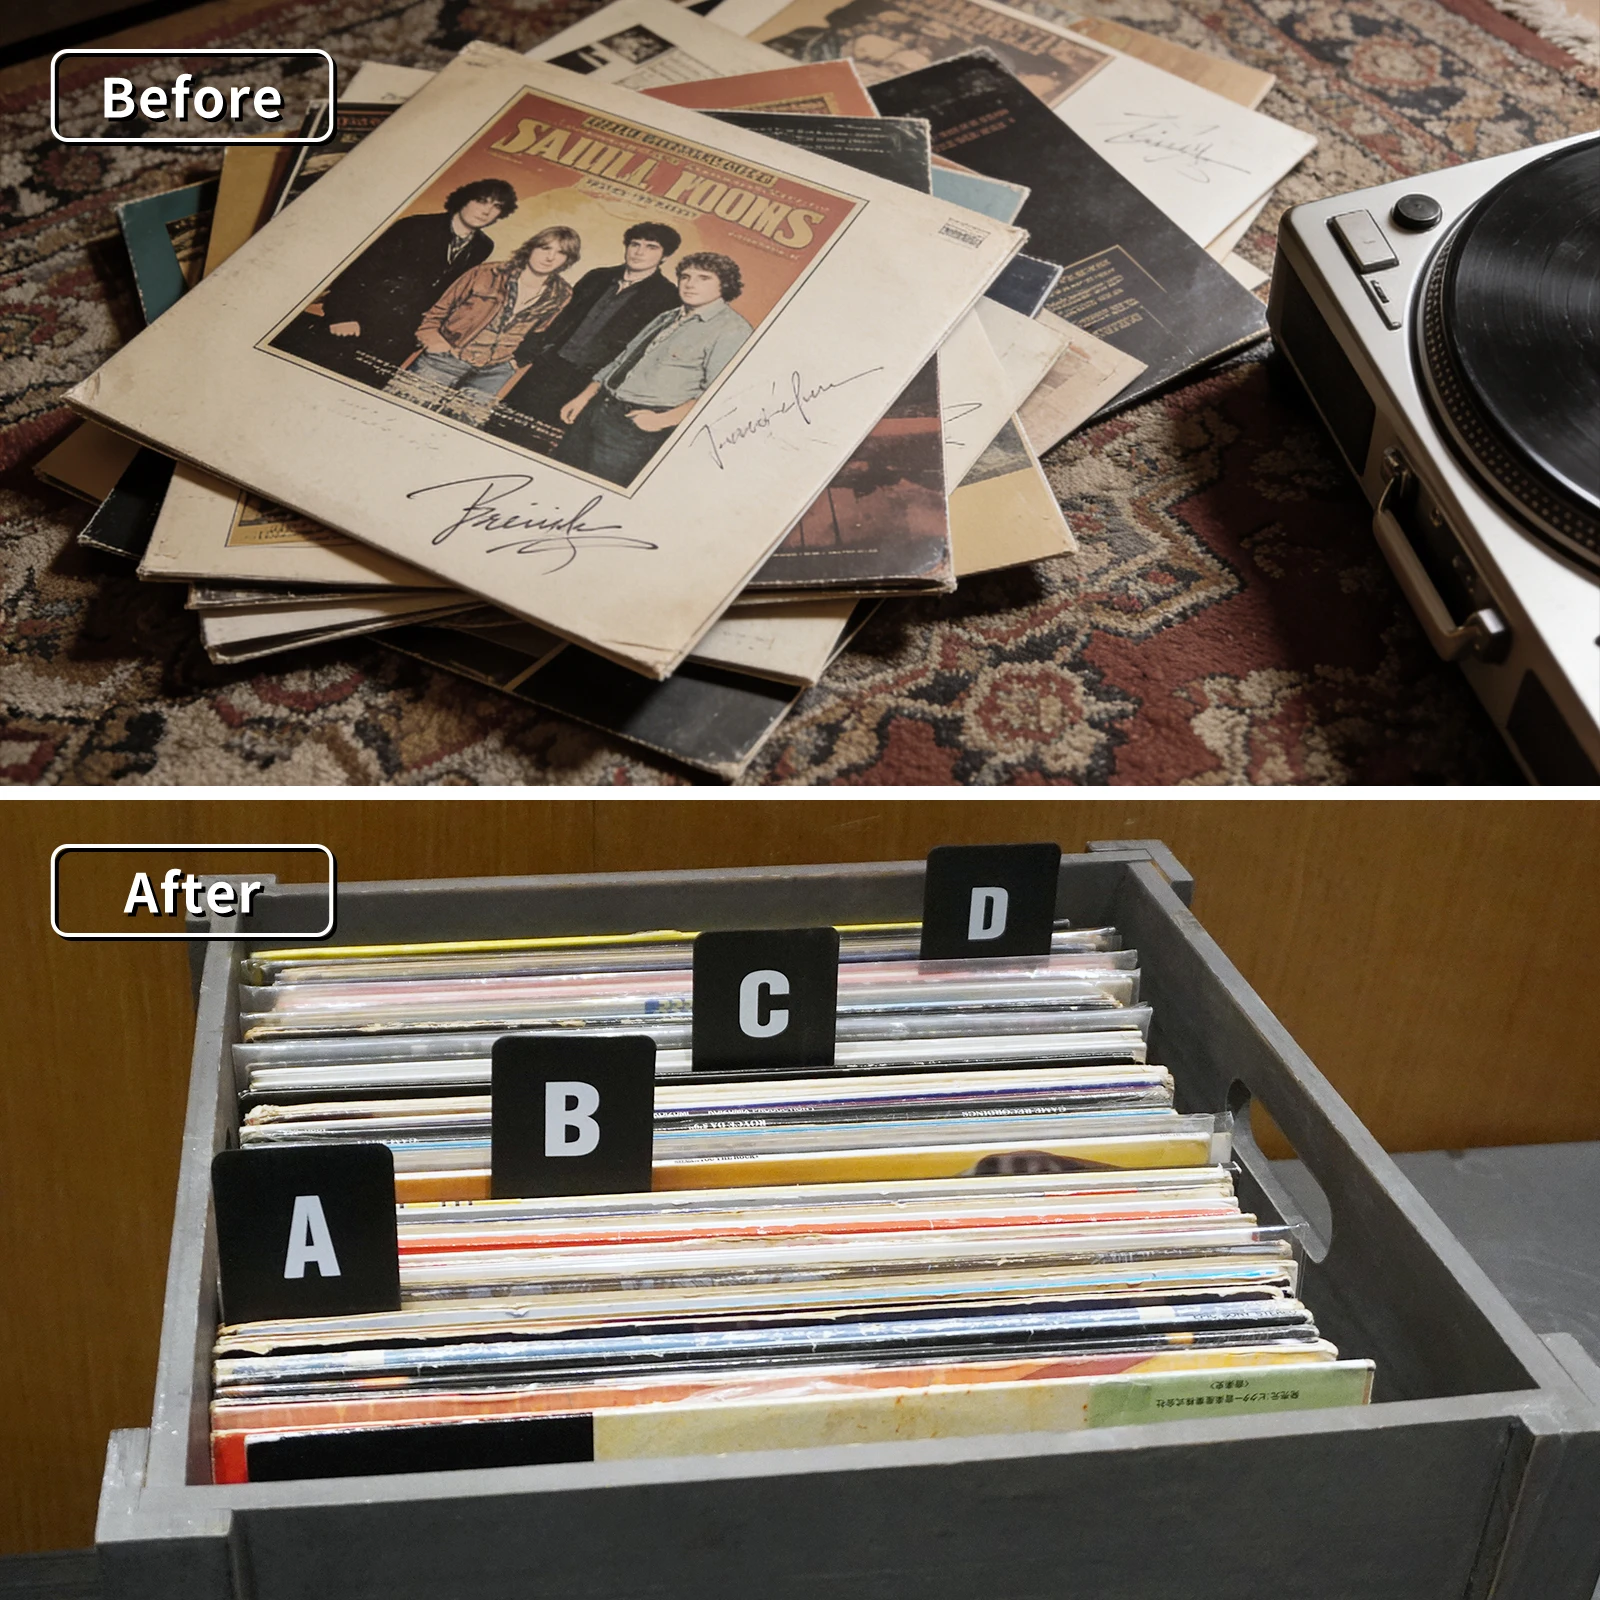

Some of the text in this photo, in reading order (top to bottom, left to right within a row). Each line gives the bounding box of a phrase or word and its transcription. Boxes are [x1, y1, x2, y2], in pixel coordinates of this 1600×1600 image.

[968, 887, 1008, 940] D
[740, 970, 790, 1038] C
[545, 1082, 600, 1157] B
[284, 1196, 341, 1279] A
